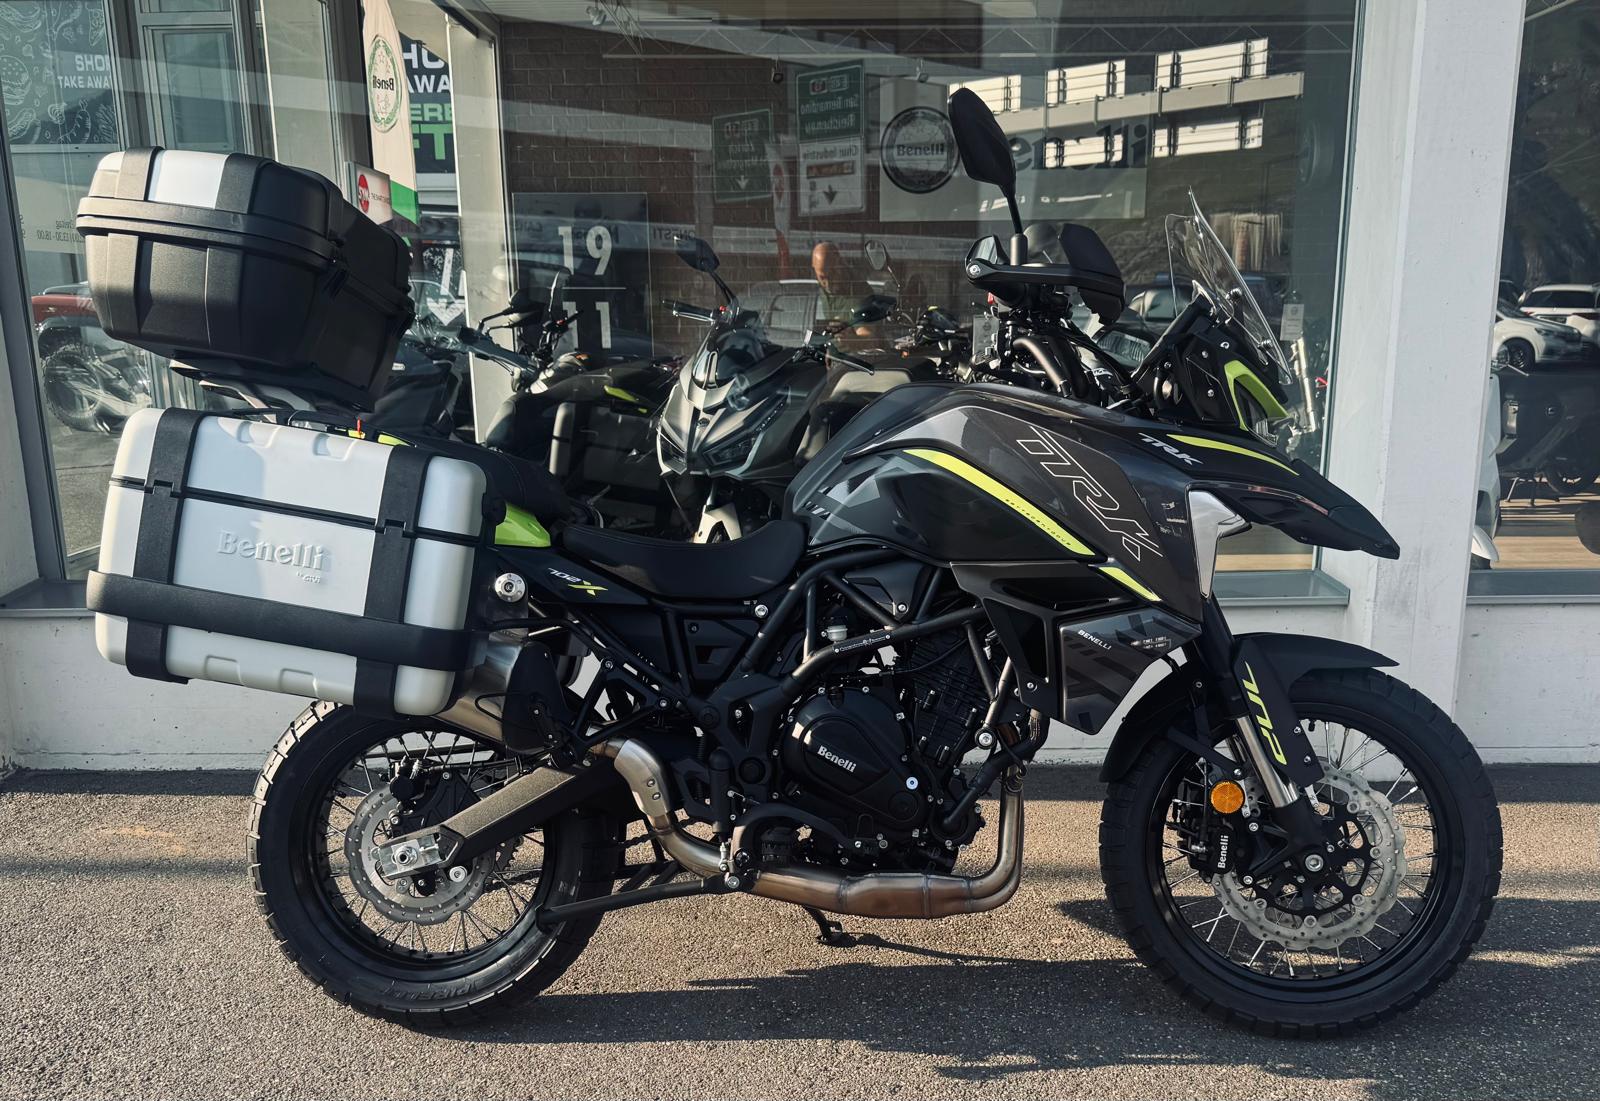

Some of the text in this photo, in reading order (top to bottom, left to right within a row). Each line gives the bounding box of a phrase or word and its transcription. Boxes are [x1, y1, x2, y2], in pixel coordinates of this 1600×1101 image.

[57, 75, 112, 89] TAKE AWA
[896, 143, 945, 157] Benelli
[557, 225, 612, 276] 19
[1138, 432, 1204, 466] TRK
[217, 530, 324, 571] Benelli
[1077, 629, 1112, 651] BENELLI
[817, 745, 857, 773] Benelli
[1217, 835, 1229, 869] Benelli
